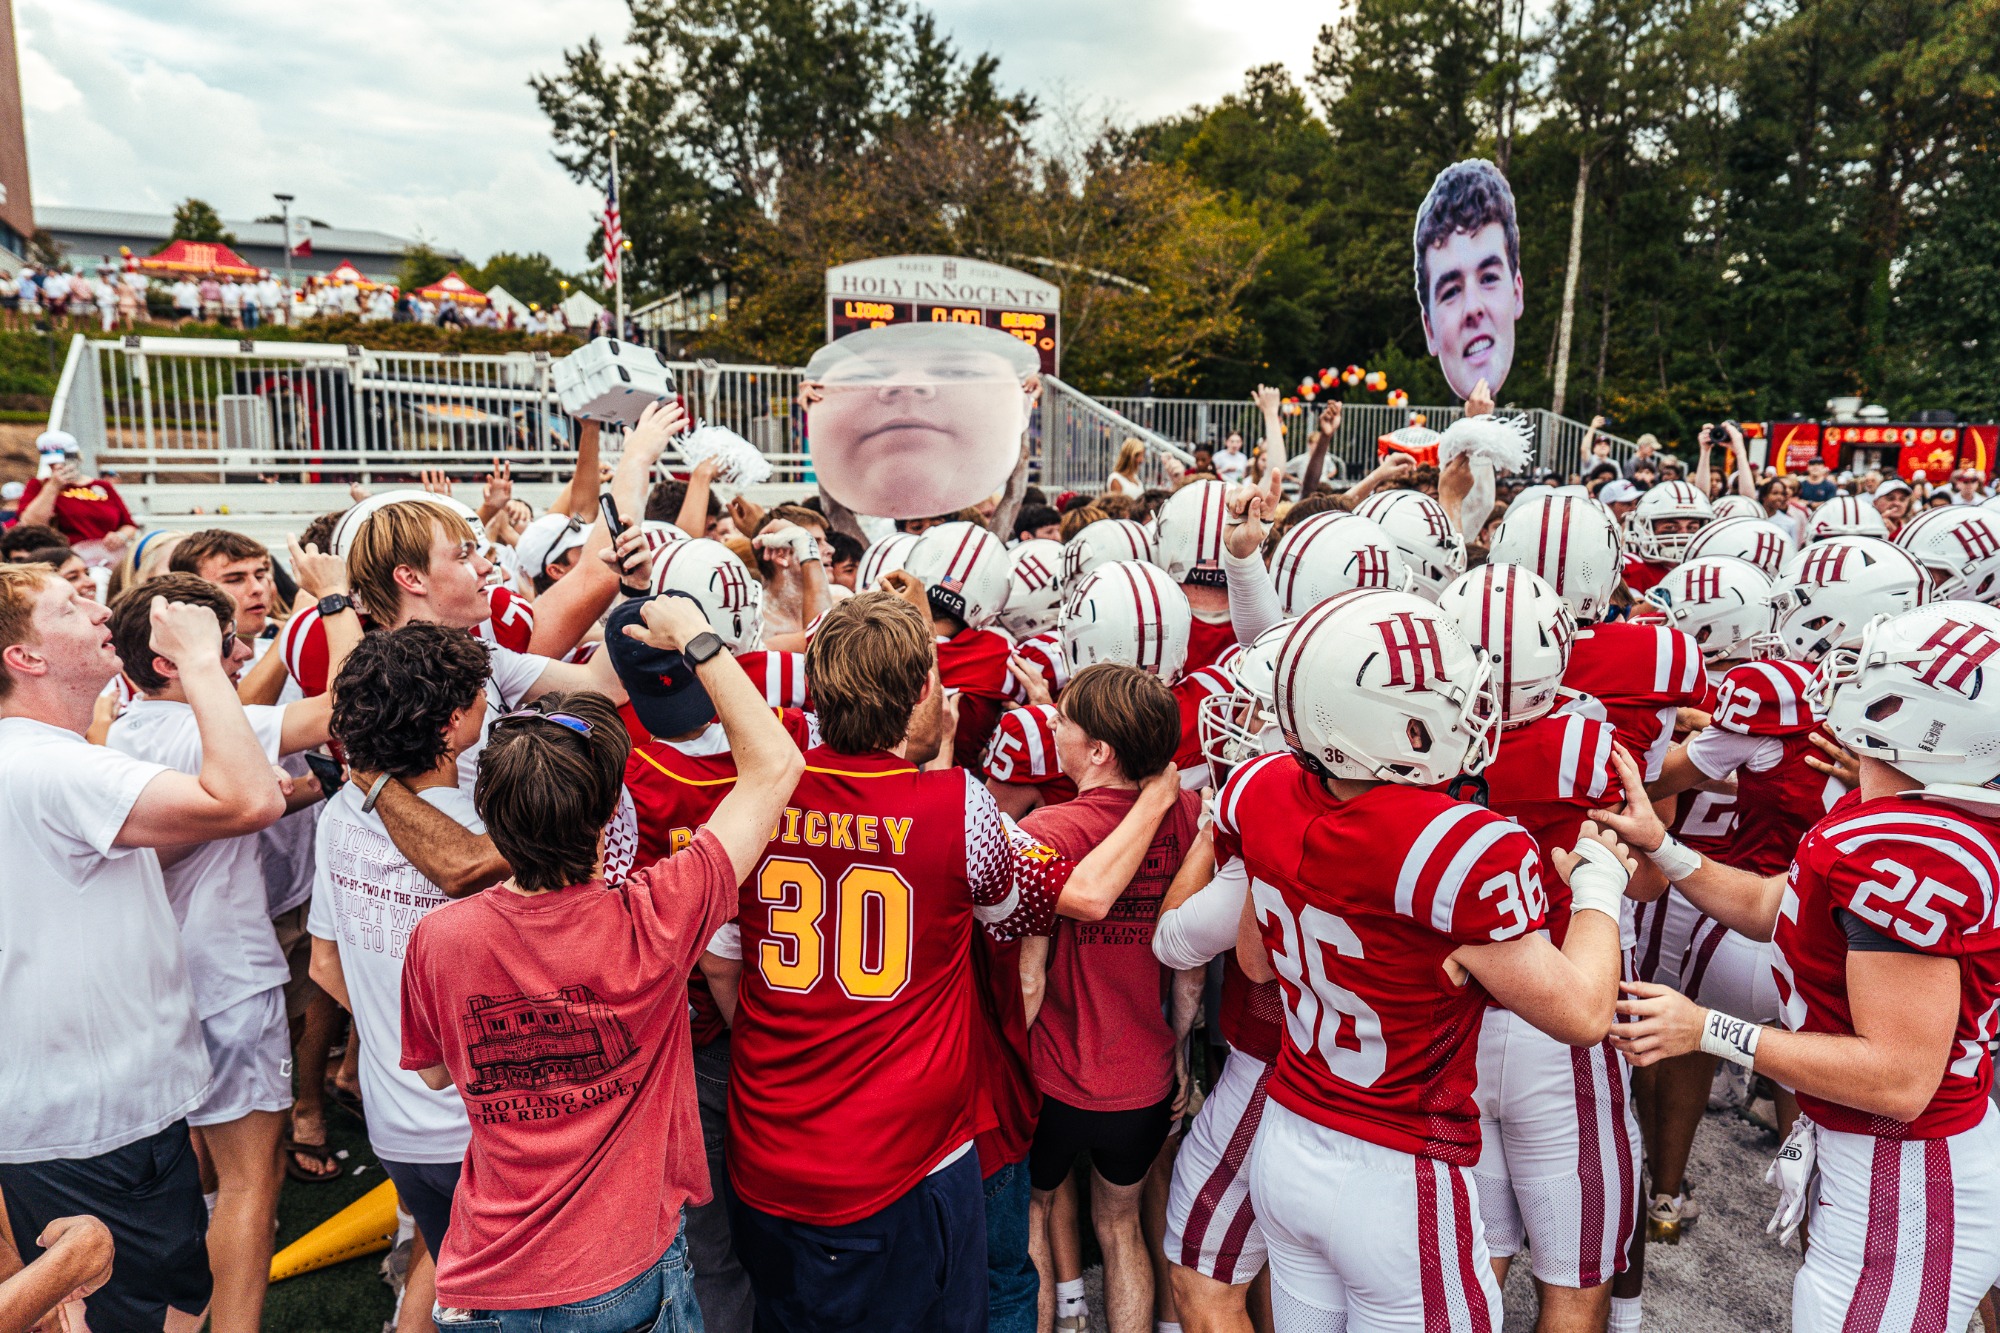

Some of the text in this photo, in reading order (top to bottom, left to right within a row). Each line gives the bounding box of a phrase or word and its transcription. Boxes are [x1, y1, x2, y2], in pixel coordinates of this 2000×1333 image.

[841, 275, 906, 296] HOLY
[1191, 571, 1227, 582] VICIS
[931, 587, 964, 610] VICIS
[1713, 677, 1762, 735] 92
[1324, 748, 1345, 764] 36
[343, 824, 389, 860] YOUR
[336, 874, 379, 897] TWO-BY-TWO
[381, 889, 391, 901] AT
[394, 891, 411, 905] THE
[361, 858, 406, 889] DON'T
[346, 892, 385, 924] DON'T
[1479, 848, 1546, 942] 36
[1848, 858, 1969, 947] 25
[361, 921, 384, 953] TO
[757, 854, 913, 1002] 30
[1080, 926, 1149, 936] ROLLING
[1103, 936, 1134, 945] RED
[1251, 876, 1387, 1088] 36
[474, 1081, 640, 1125] THE RED CARPET
[481, 1078, 623, 1113] ROLLING OUT
